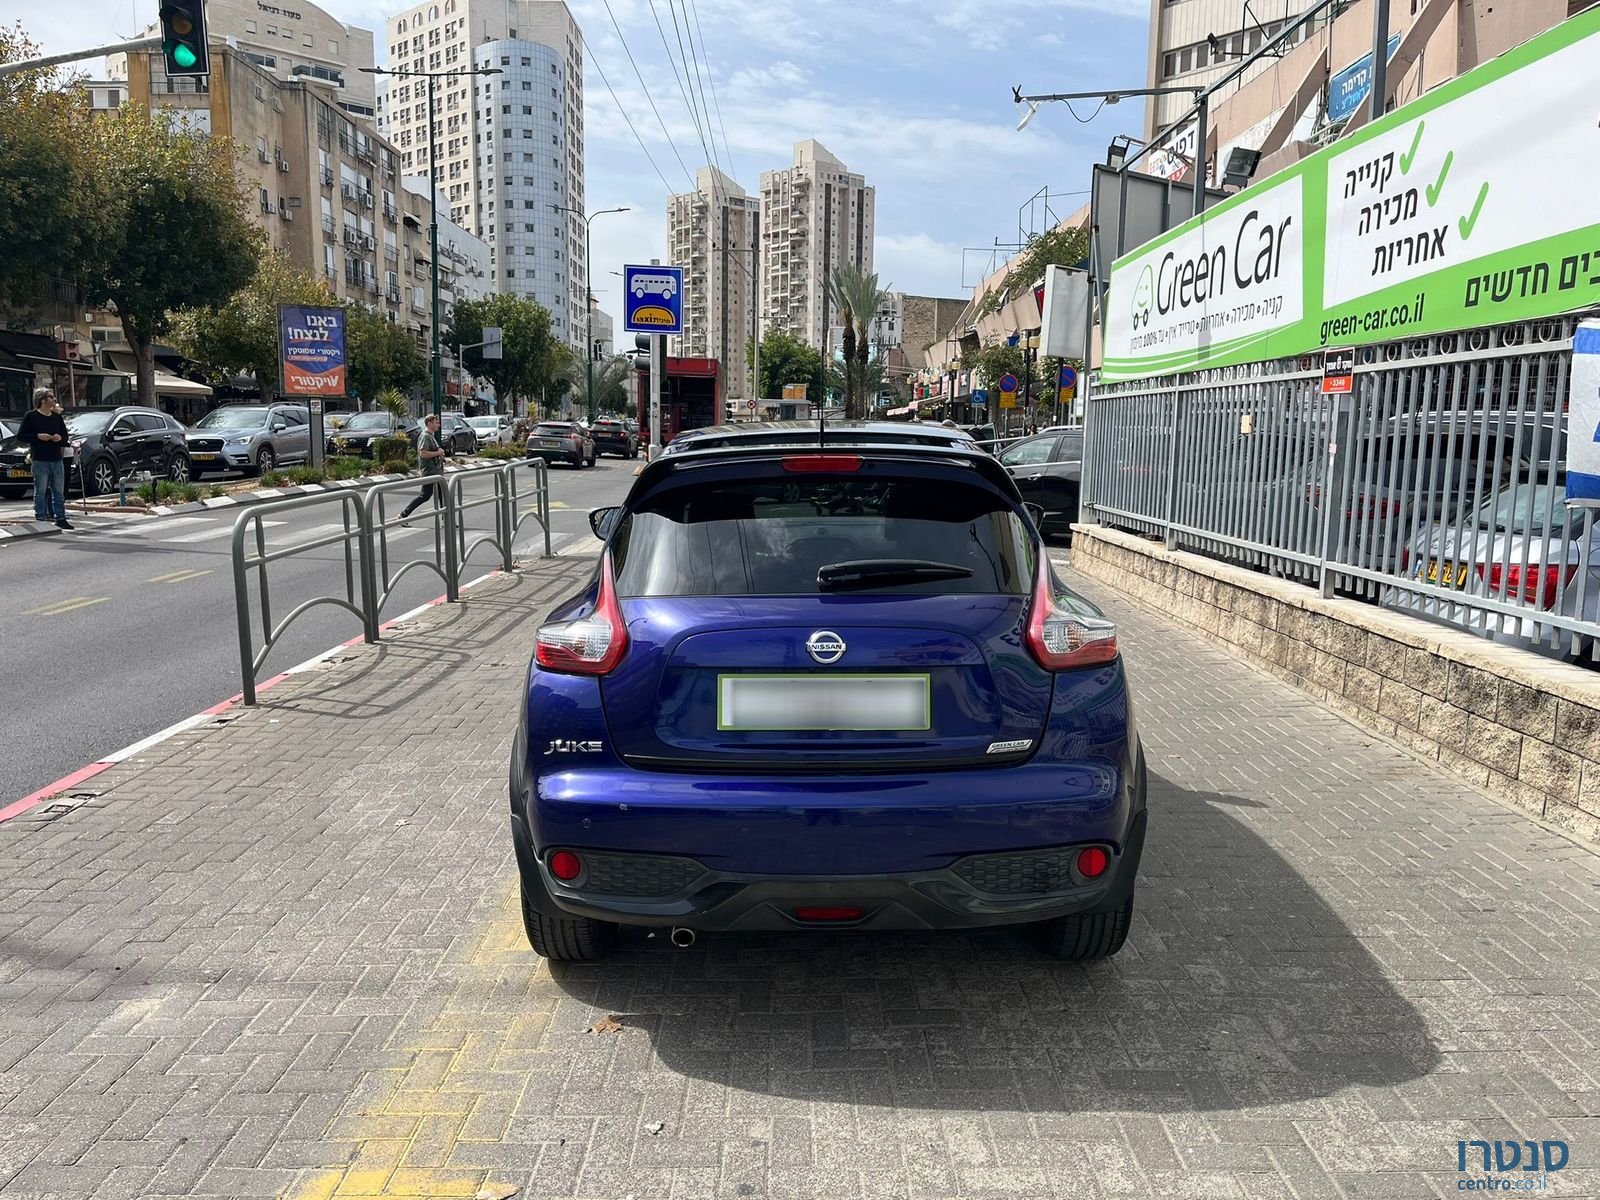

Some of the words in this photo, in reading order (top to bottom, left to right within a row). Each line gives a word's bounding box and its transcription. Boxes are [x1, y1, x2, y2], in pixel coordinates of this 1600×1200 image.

[1166, 130, 1195, 165] דפוס
[1344, 151, 1395, 199] קנייה
[1358, 187, 1418, 236] מכירה
[1157, 245, 1226, 316] Green
[1234, 210, 1292, 290] Car
[1371, 225, 1449, 276] אחריות
[1464, 262, 1550, 308] חדשים
[306, 315, 338, 328] באנו
[1231, 303, 1255, 324] מכירה
[1262, 295, 1283, 319] קניה
[1320, 293, 1425, 345] green-car.co.il
[287, 327, 329, 341] לנצח!
[1200, 311, 1225, 333] אחריות
[1143, 332, 1157, 347] 100%
[543, 739, 603, 755] JUKE
